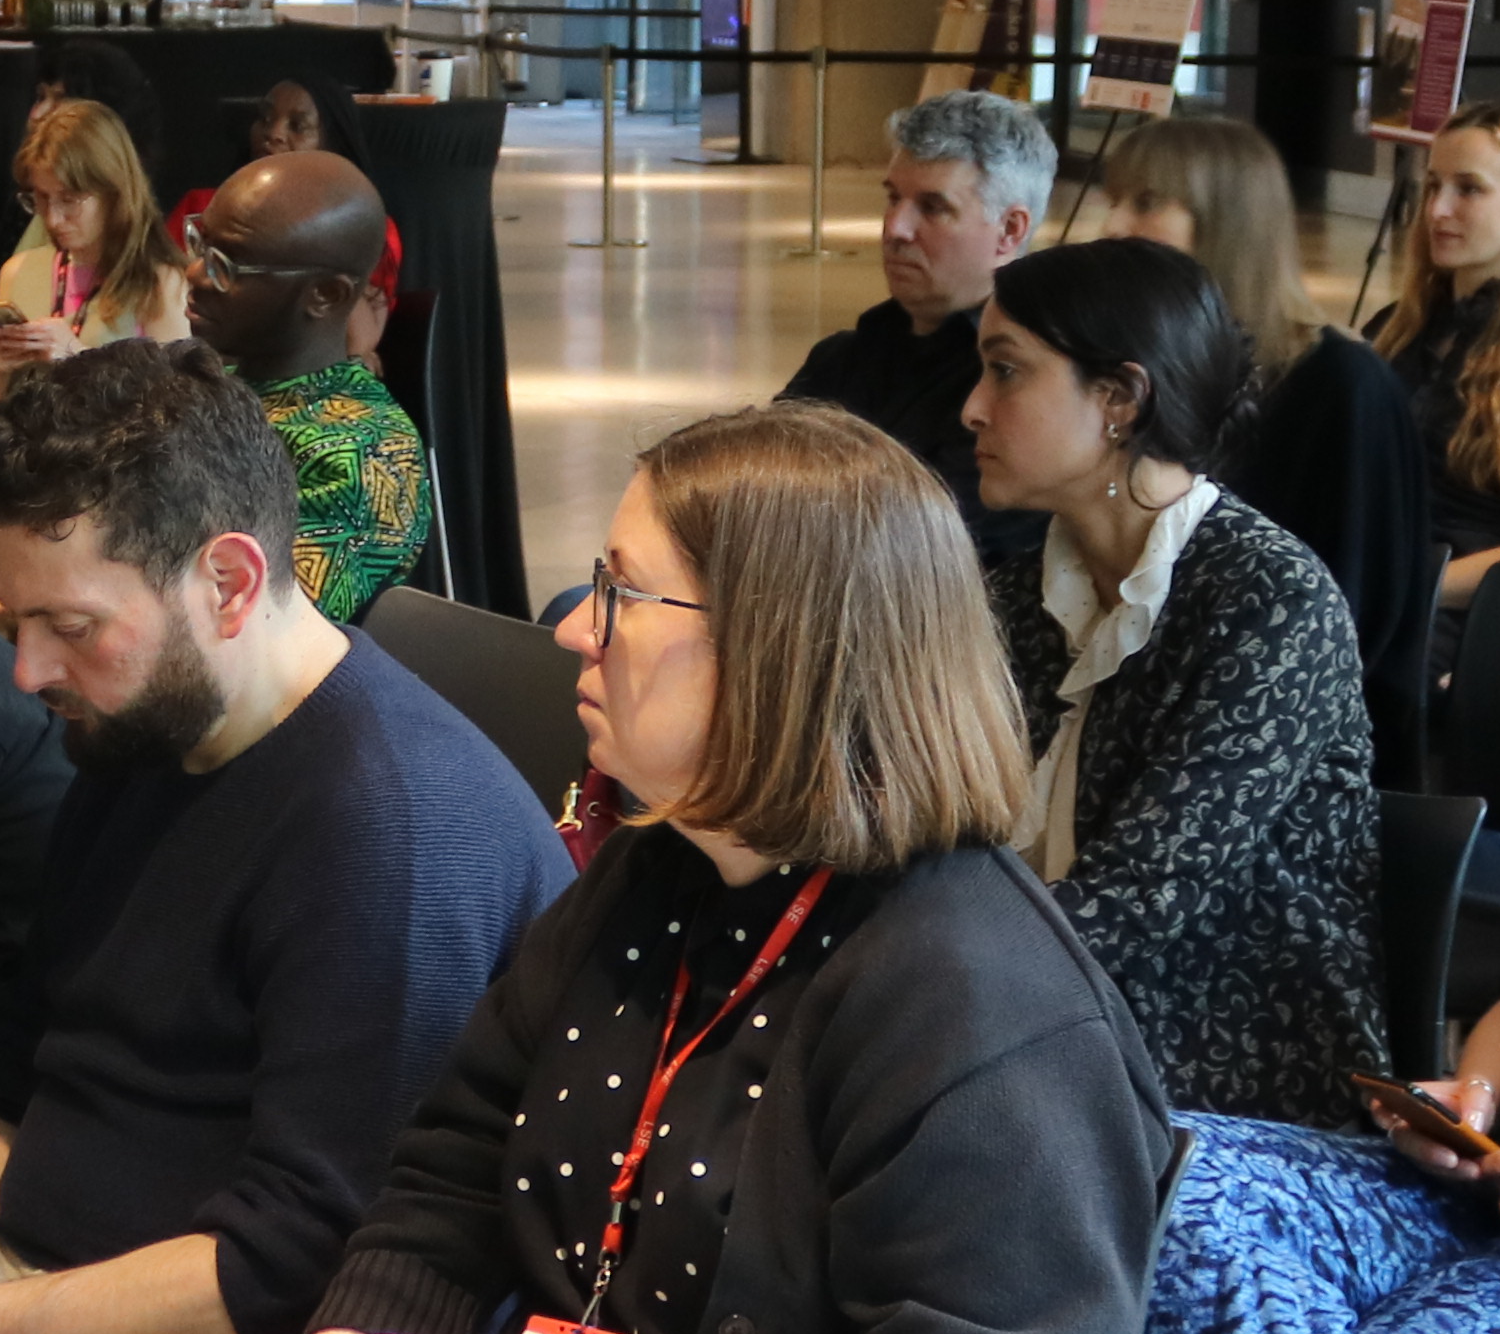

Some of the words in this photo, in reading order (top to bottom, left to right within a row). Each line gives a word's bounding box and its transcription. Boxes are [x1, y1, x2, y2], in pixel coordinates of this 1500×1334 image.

[786, 897, 809, 924] LSE
[747, 957, 769, 983] LSE
[636, 1120, 655, 1150] LSE
